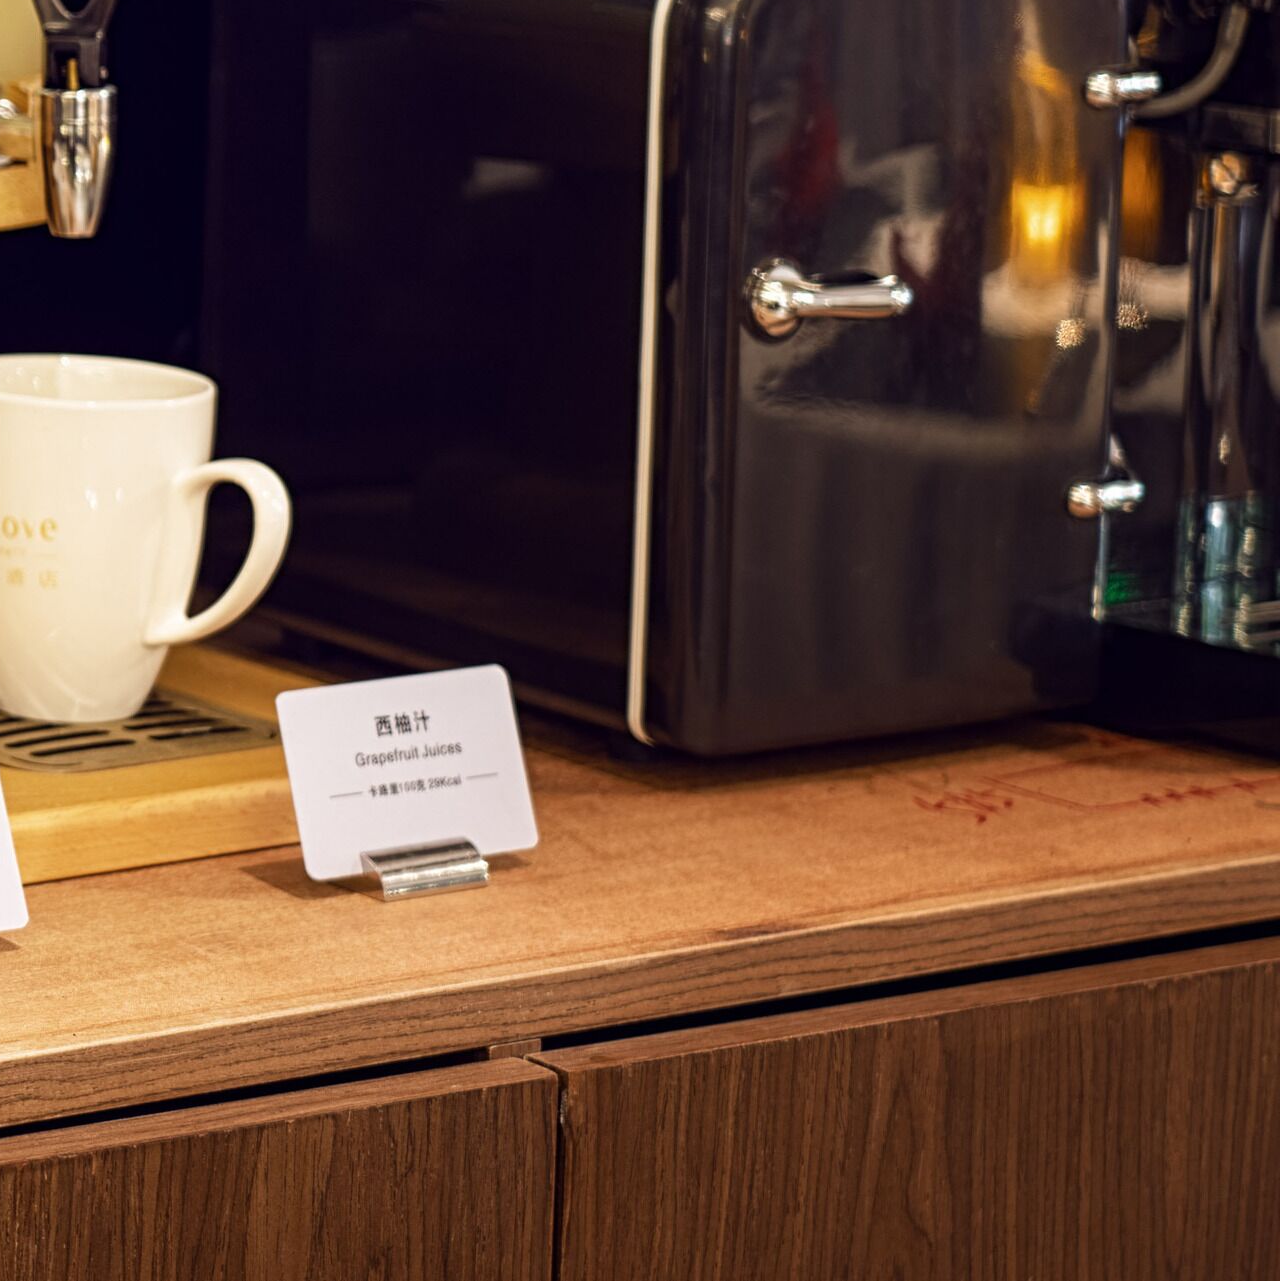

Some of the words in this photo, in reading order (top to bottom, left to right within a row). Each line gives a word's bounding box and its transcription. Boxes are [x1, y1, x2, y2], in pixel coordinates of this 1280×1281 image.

[375, 711, 429, 736] 西柚汁
[355, 747, 419, 767] Grapefruit
[422, 742, 462, 758] Juices
